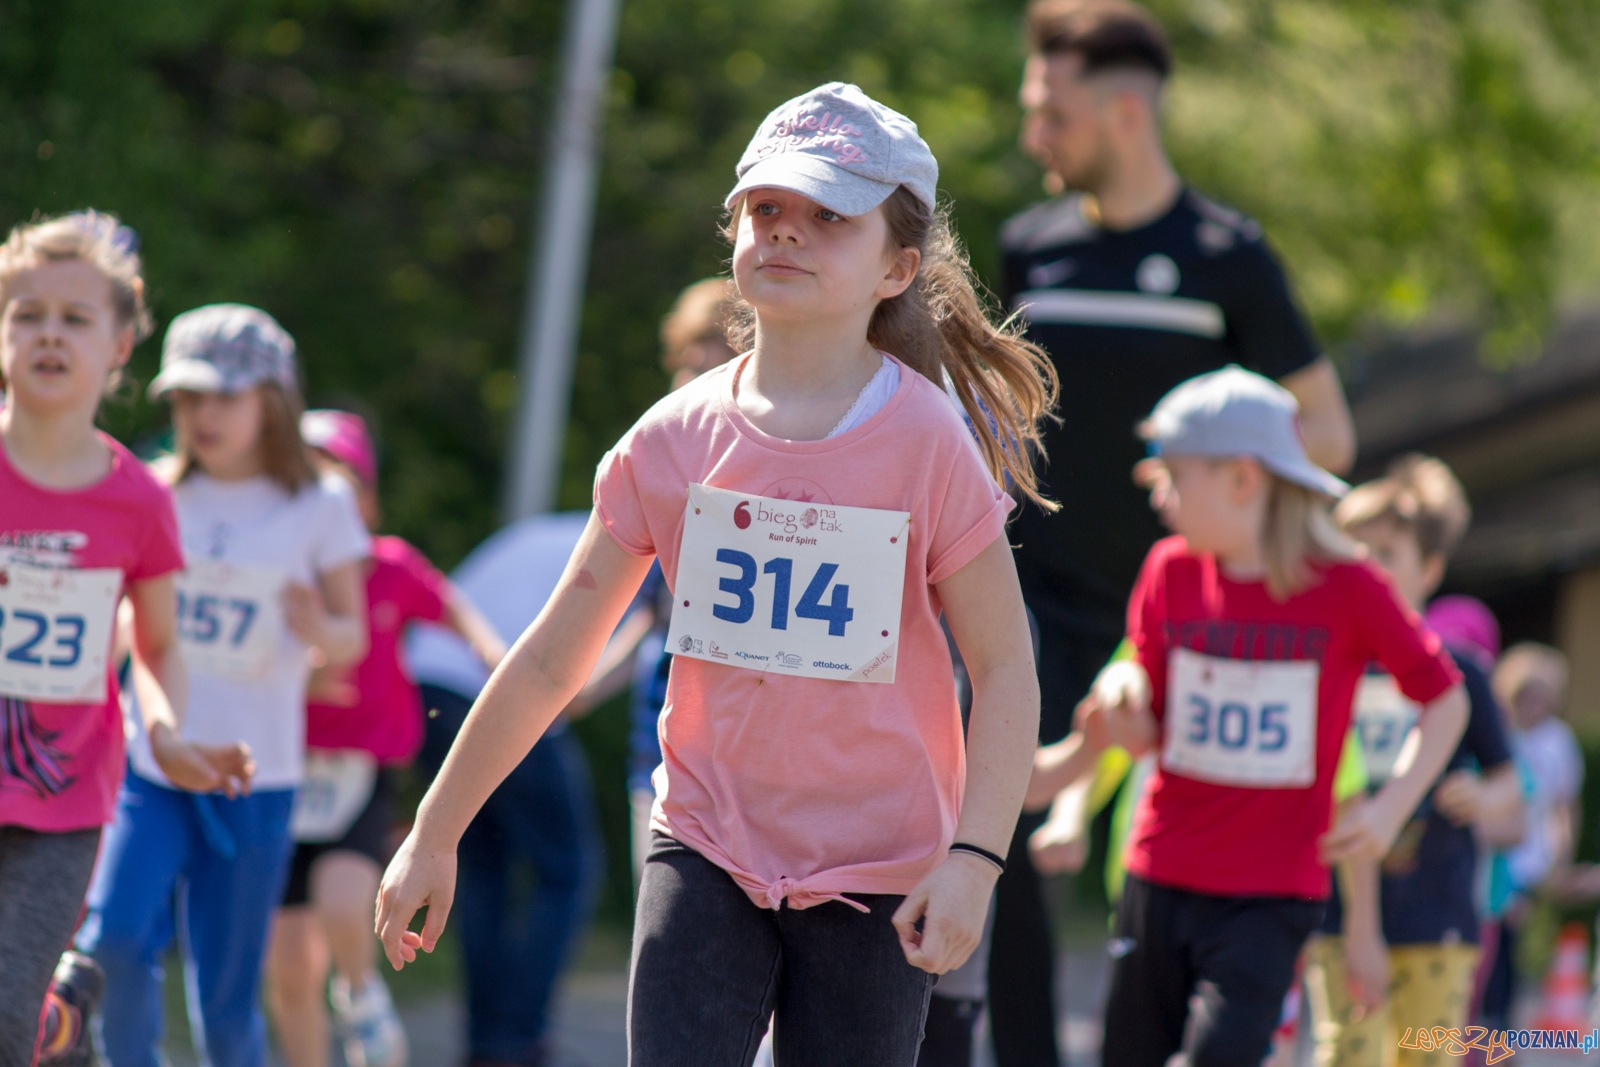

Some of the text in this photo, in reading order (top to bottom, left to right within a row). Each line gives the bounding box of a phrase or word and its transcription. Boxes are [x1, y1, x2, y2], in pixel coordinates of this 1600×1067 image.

[775, 109, 862, 137] Hello
[757, 129, 866, 165] Spring
[733, 500, 798, 533] 6 bieg
[820, 508, 836, 519] na
[820, 519, 843, 533] tak
[769, 532, 818, 546] Run of Spirit
[712, 547, 854, 637] 314
[0, 608, 87, 668] 23
[812, 660, 853, 671] ottobock.
[1187, 694, 1290, 752] 305
